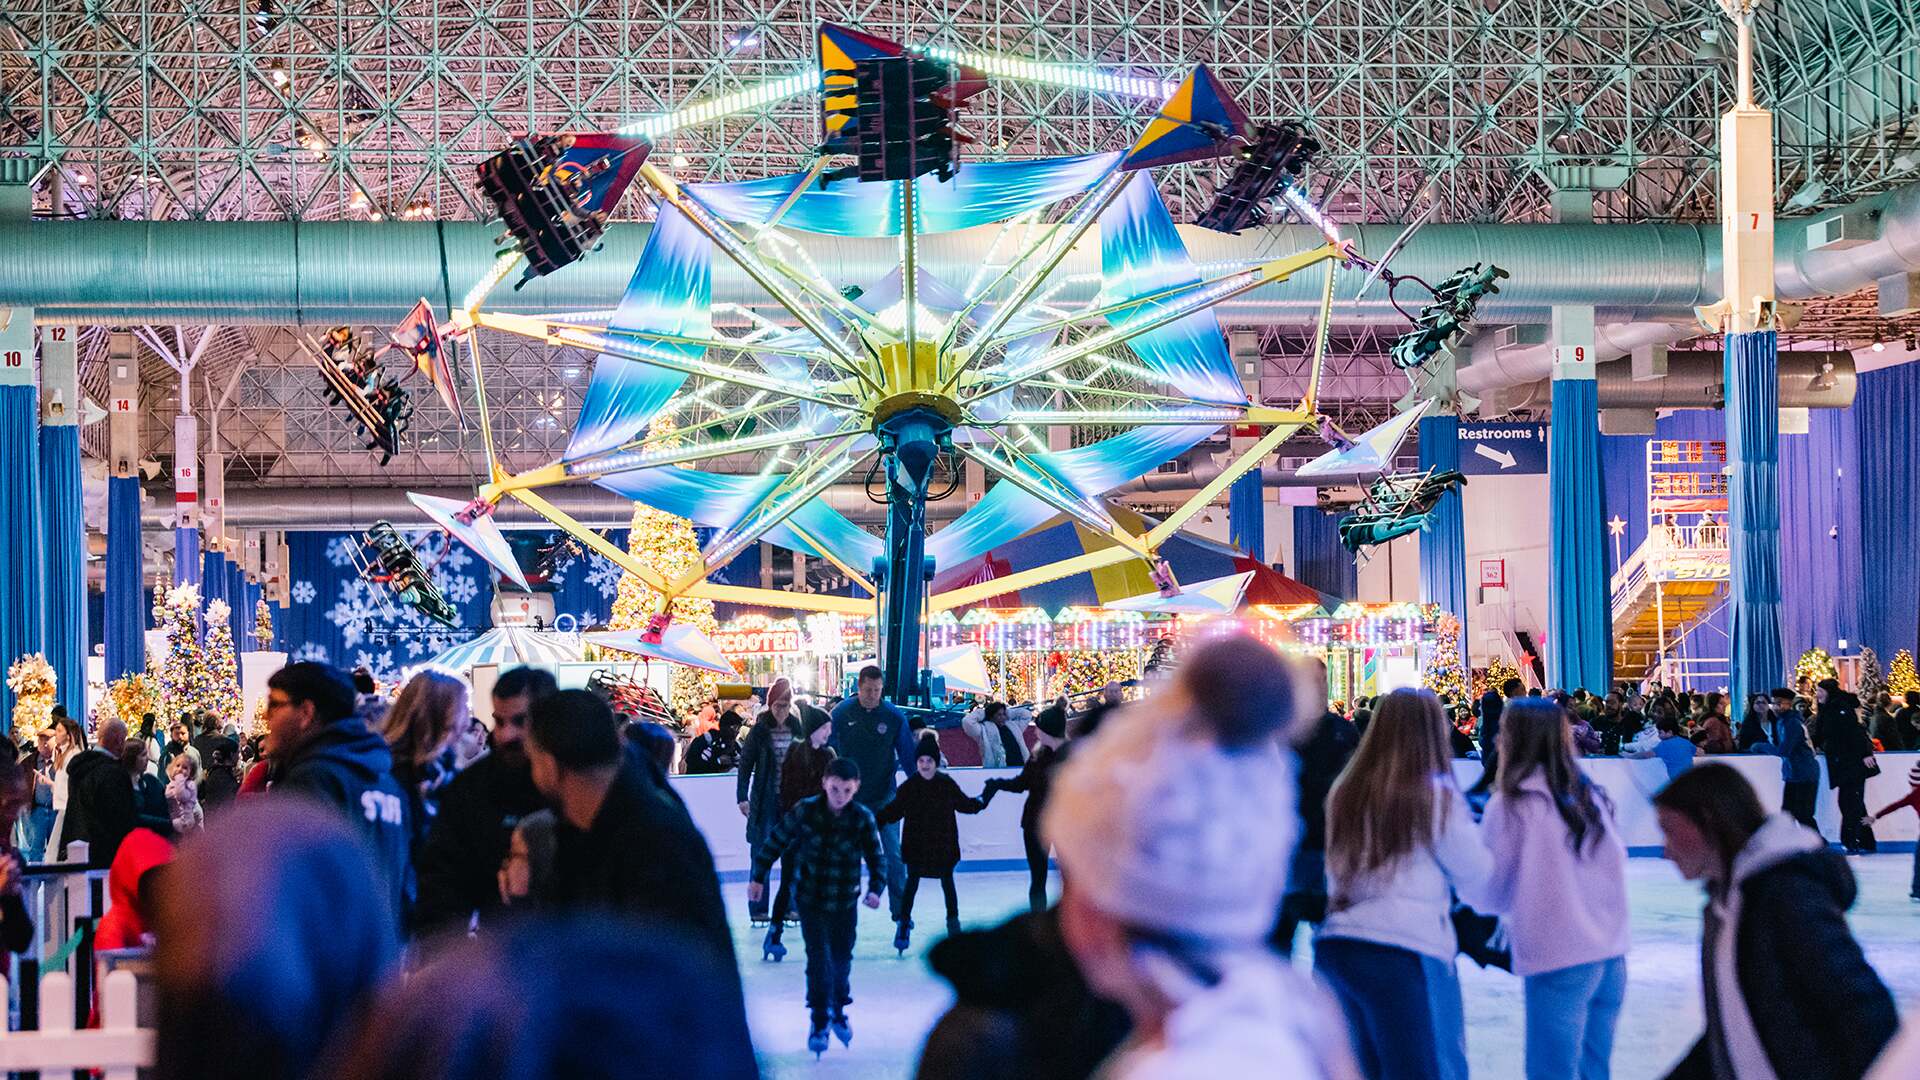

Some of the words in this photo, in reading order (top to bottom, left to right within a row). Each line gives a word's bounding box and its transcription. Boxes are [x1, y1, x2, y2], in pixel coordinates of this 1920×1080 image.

[1751, 213, 1759, 230] 7
[51, 327, 66, 341] 12
[4, 351, 21, 367] 10
[1575, 346, 1584, 362] 9
[117, 400, 129, 411] 14
[1458, 428, 1532, 440] Restrooms
[181, 468, 191, 477] 16
[974, 493, 981, 501] 17
[1674, 567, 1731, 579] SLID
[712, 631, 798, 652] SCOOTER
